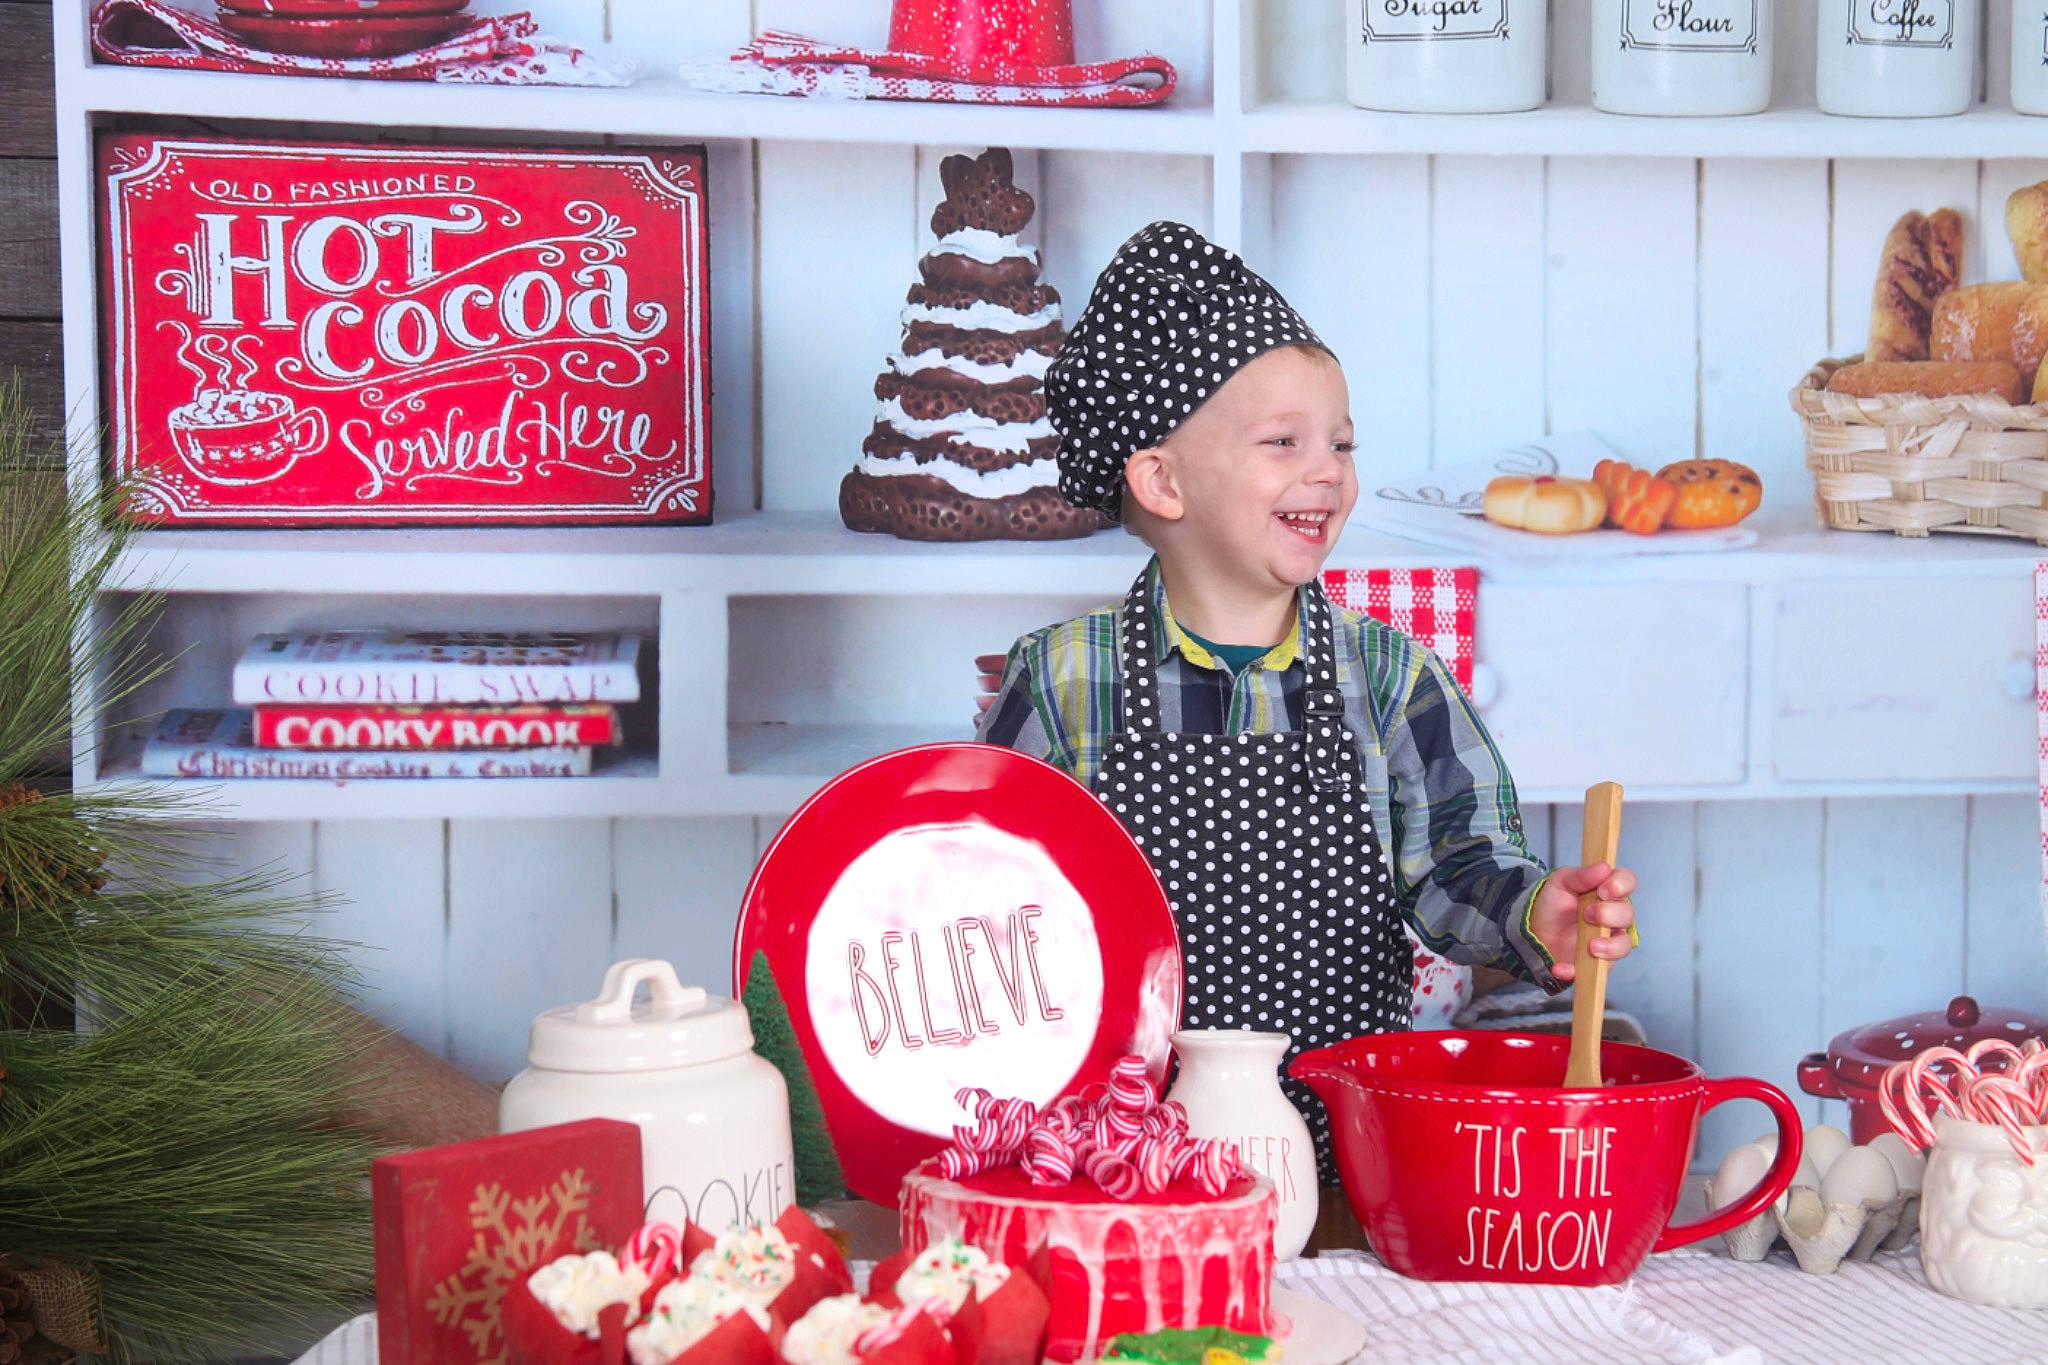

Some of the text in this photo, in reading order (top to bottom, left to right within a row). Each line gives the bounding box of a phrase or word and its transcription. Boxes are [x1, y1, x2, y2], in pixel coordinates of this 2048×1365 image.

[1652, 0, 1734, 33] Flour
[1870, 0, 1937, 40] Coffee
[209, 173, 476, 202] OLD FASHIONED
[194, 203, 487, 330] HOT
[339, 390, 677, 500] Served Here
[263, 670, 611, 701] COOKIE SWAP
[453, 719, 581, 747] BOOK
[847, 903, 1064, 1056] BELIEVE
[1454, 1120, 1618, 1200] 'TIS THE
[1458, 1206, 1613, 1273] SEASON
